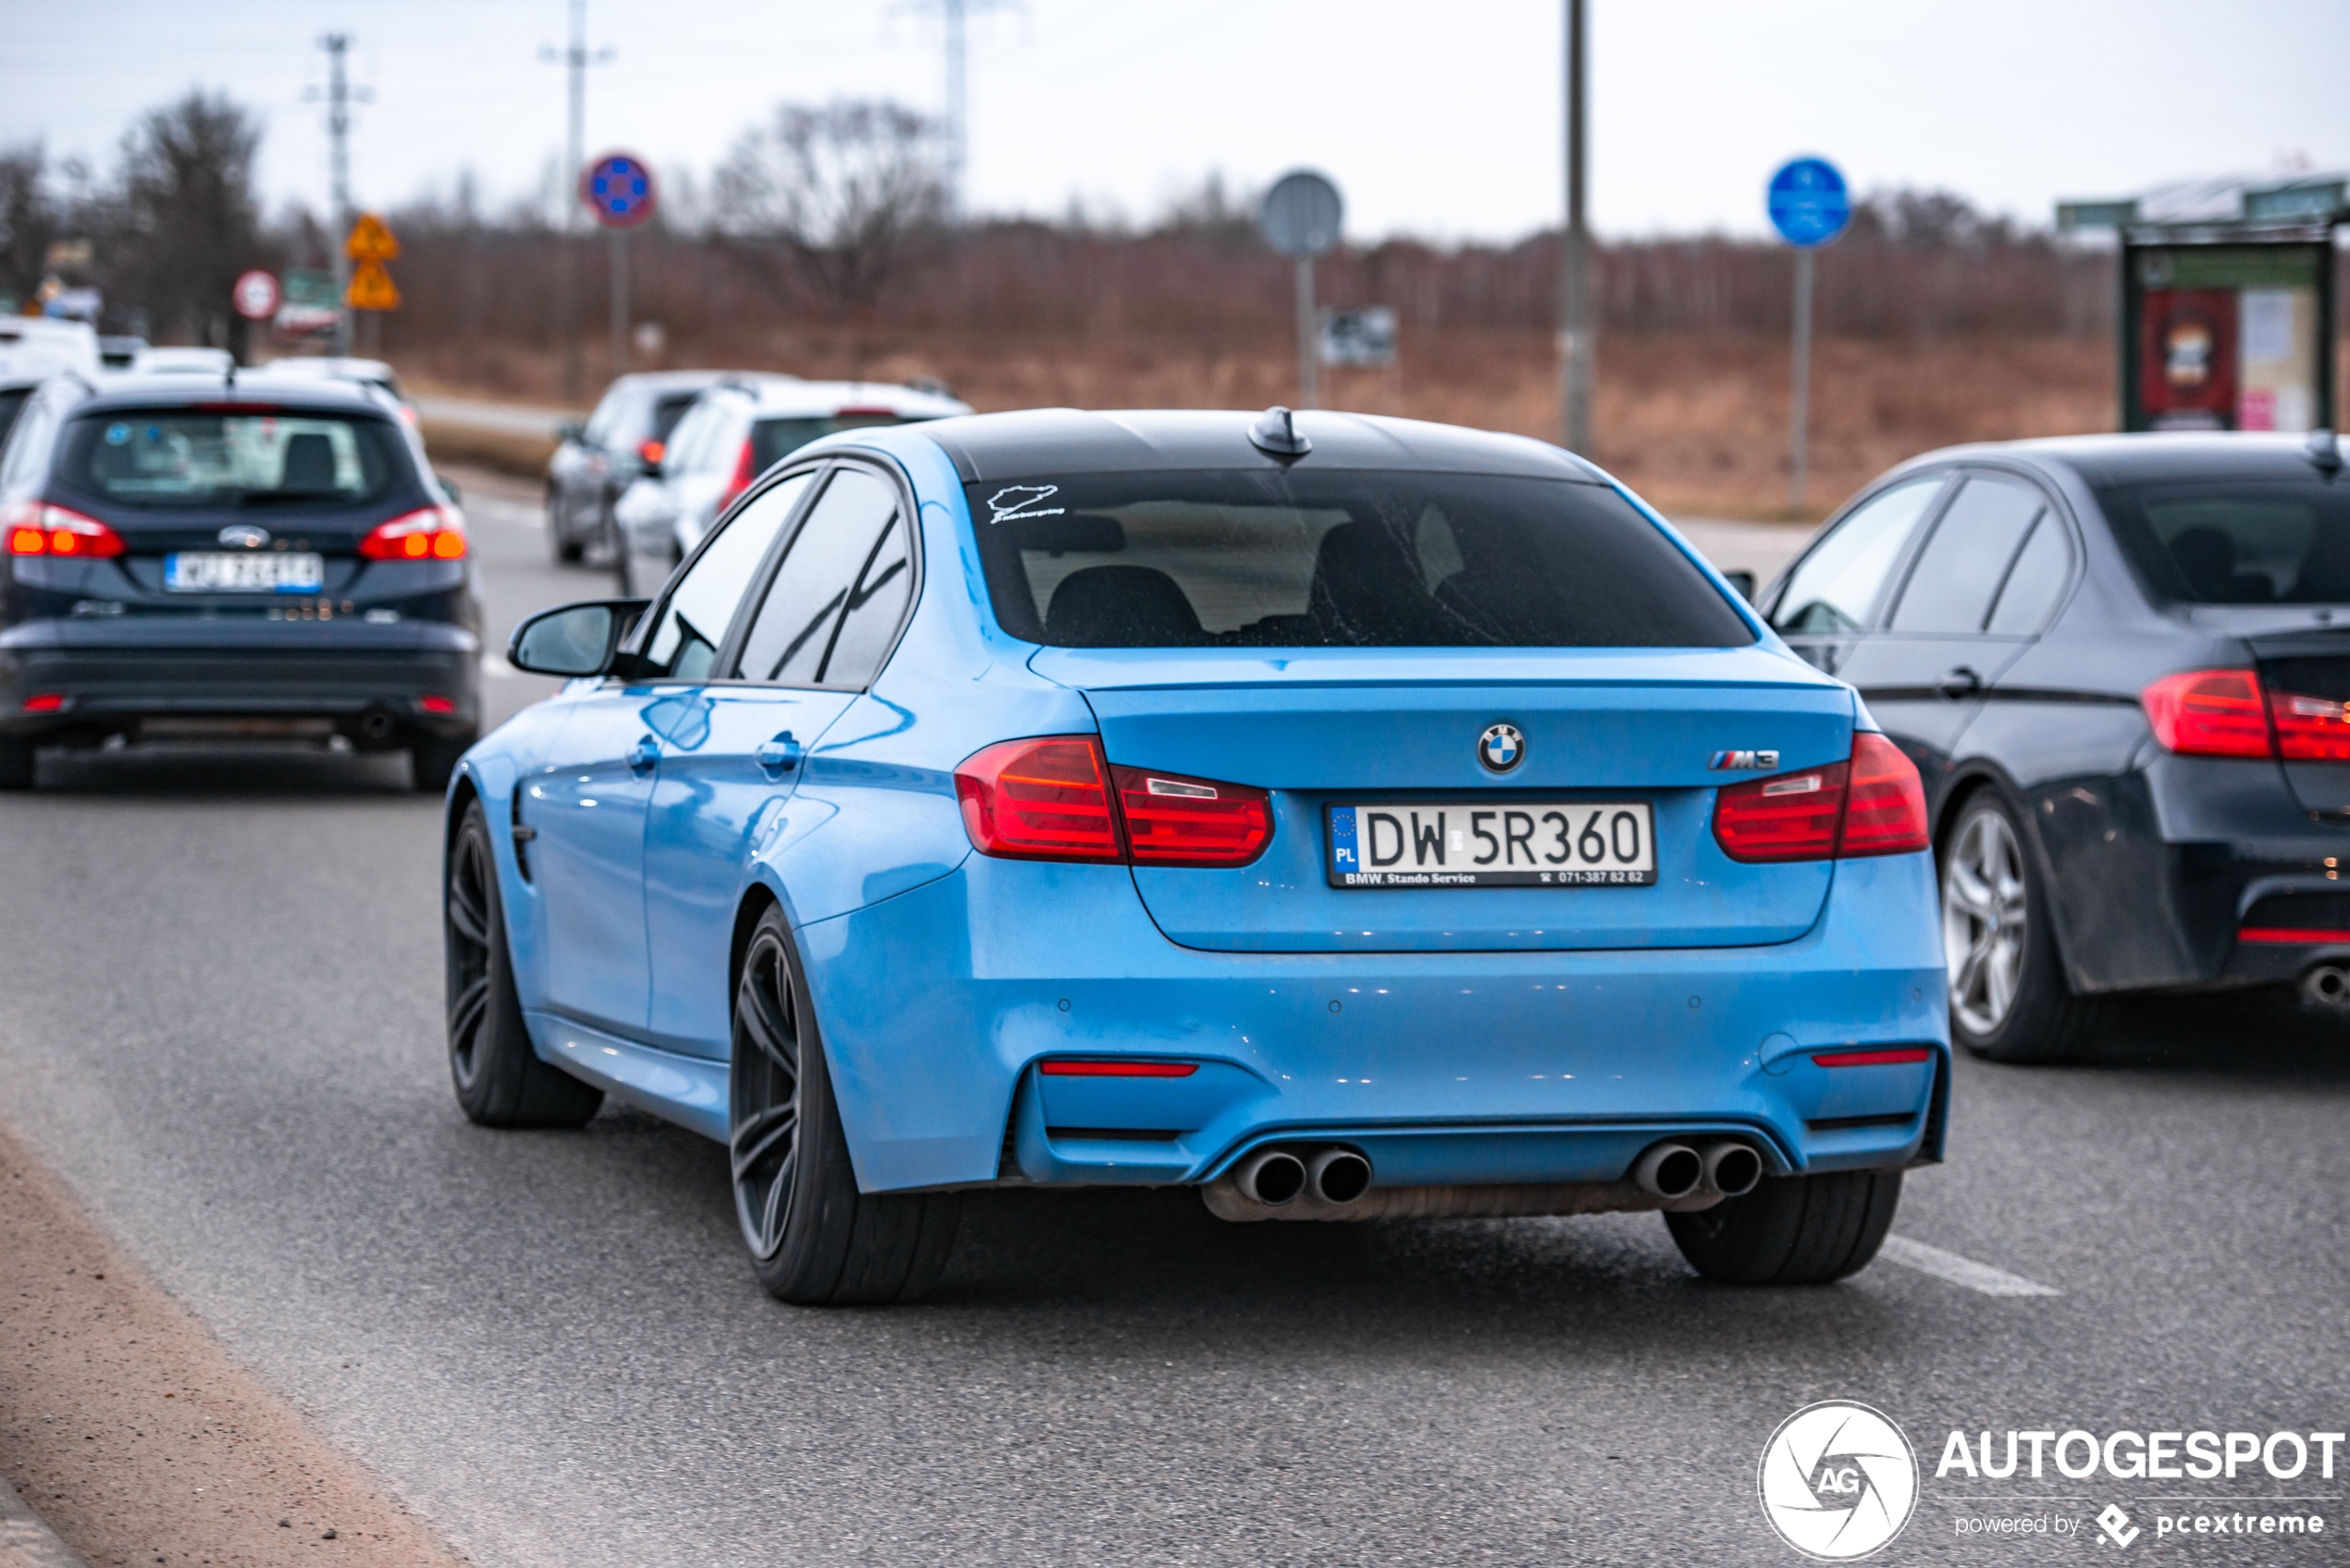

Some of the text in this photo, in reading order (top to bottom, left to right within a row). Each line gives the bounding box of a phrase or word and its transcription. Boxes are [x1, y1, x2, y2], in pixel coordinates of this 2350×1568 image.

[1483, 725, 1523, 742] BMW
[1725, 749, 1780, 770] M3
[1367, 810, 1639, 867] DW 5R360
[1336, 847, 1356, 863] PL
[1387, 872, 1430, 884] Stando
[1431, 872, 1477, 884] Service
[1558, 871, 1644, 883] 071-387 82 82
